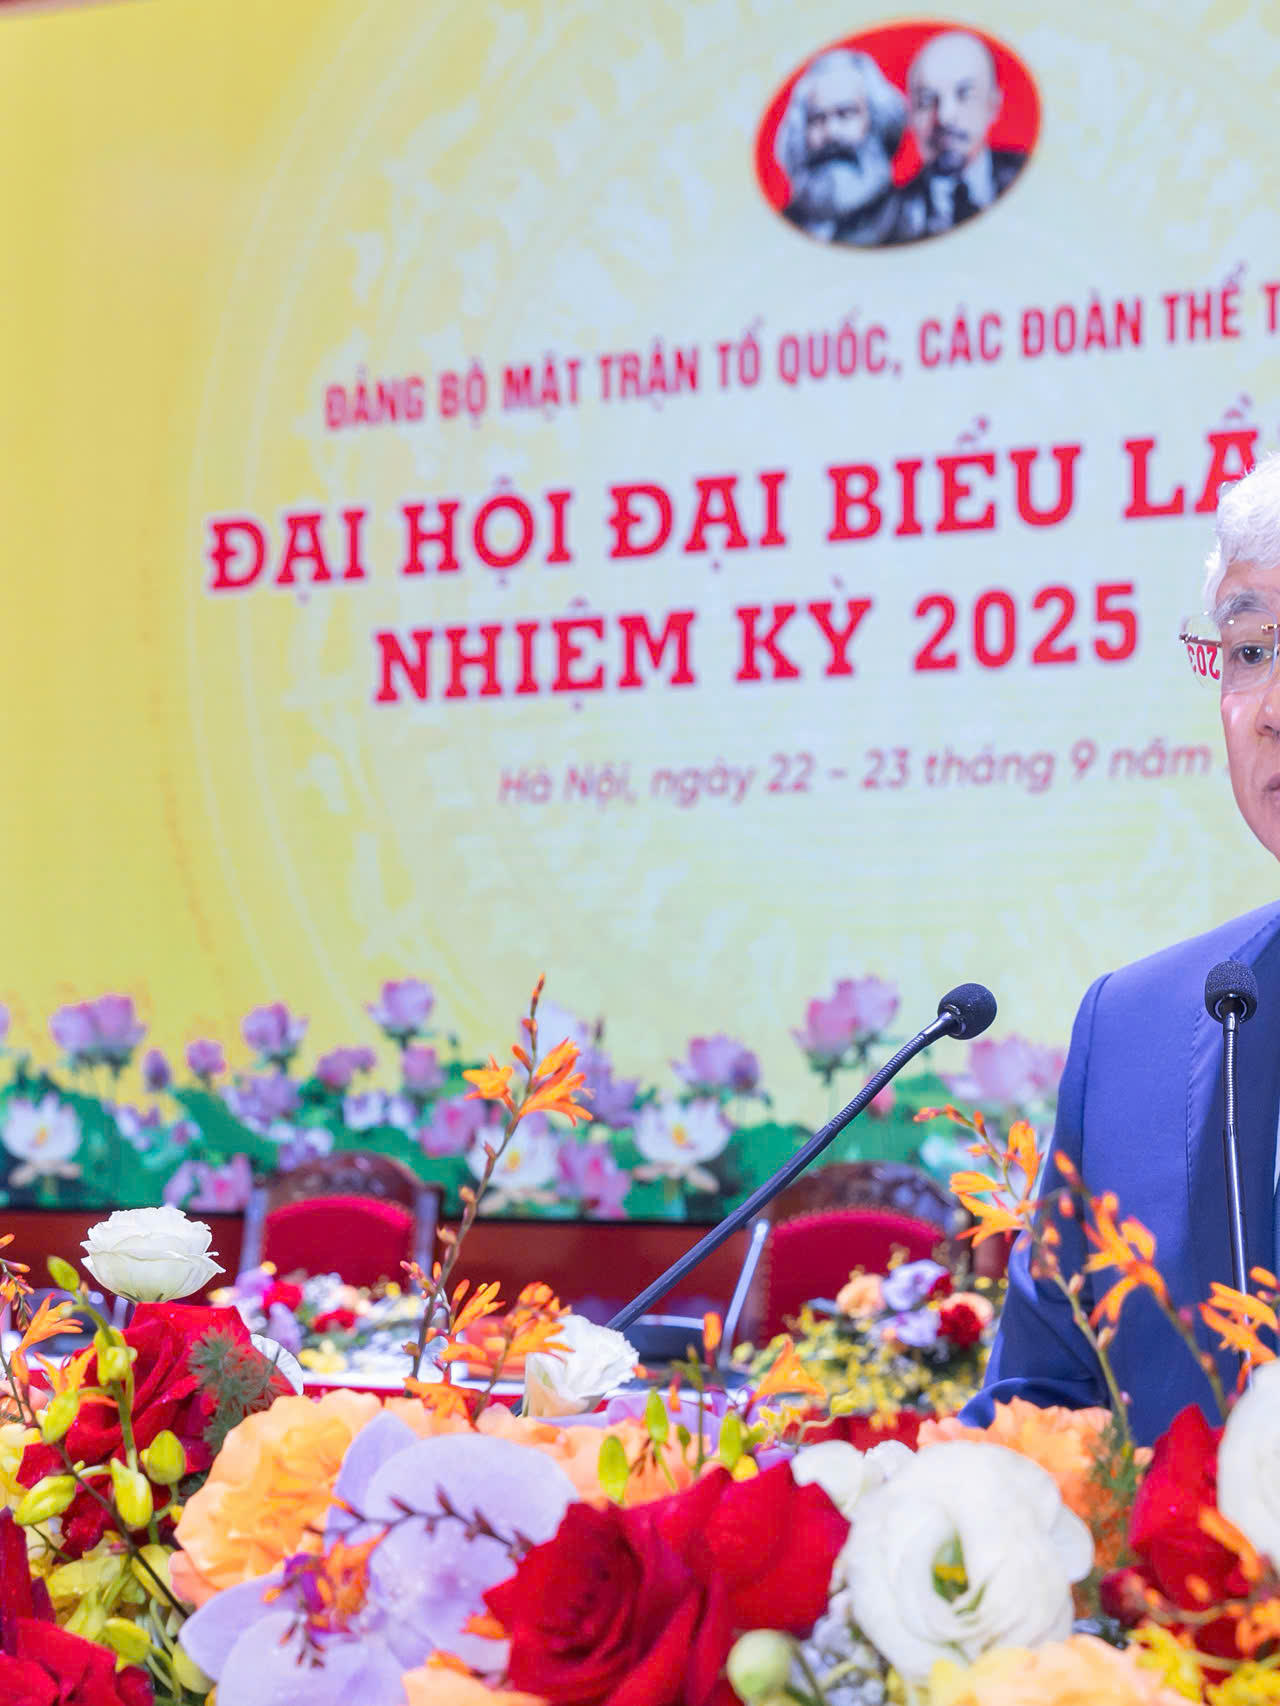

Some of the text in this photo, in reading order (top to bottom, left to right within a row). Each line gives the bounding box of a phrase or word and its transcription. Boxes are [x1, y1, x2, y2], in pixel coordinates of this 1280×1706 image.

[325, 361, 425, 432] ĐẢNG
[438, 355, 488, 430] BỘ
[599, 335, 700, 412] TRẬN
[777, 305, 903, 388] QUỐC,
[917, 302, 1003, 369] CÁC
[1020, 287, 1143, 358] ĐOÀN
[1162, 261, 1246, 344] THỂ
[210, 508, 367, 604] ĐẠI
[402, 474, 572, 588] HỘI
[609, 470, 787, 571] ĐẠI
[826, 414, 1082, 542] BIỂU
[375, 574, 1138, 709] NHIỆM KỲ 2025
[500, 764, 553, 804] Hà
[651, 756, 757, 809] ngày
[766, 751, 814, 794] 22
[861, 747, 911, 790] 23
[924, 744, 1057, 795] tháng
[1069, 737, 1097, 780] 9
[1108, 736, 1212, 779] năm
